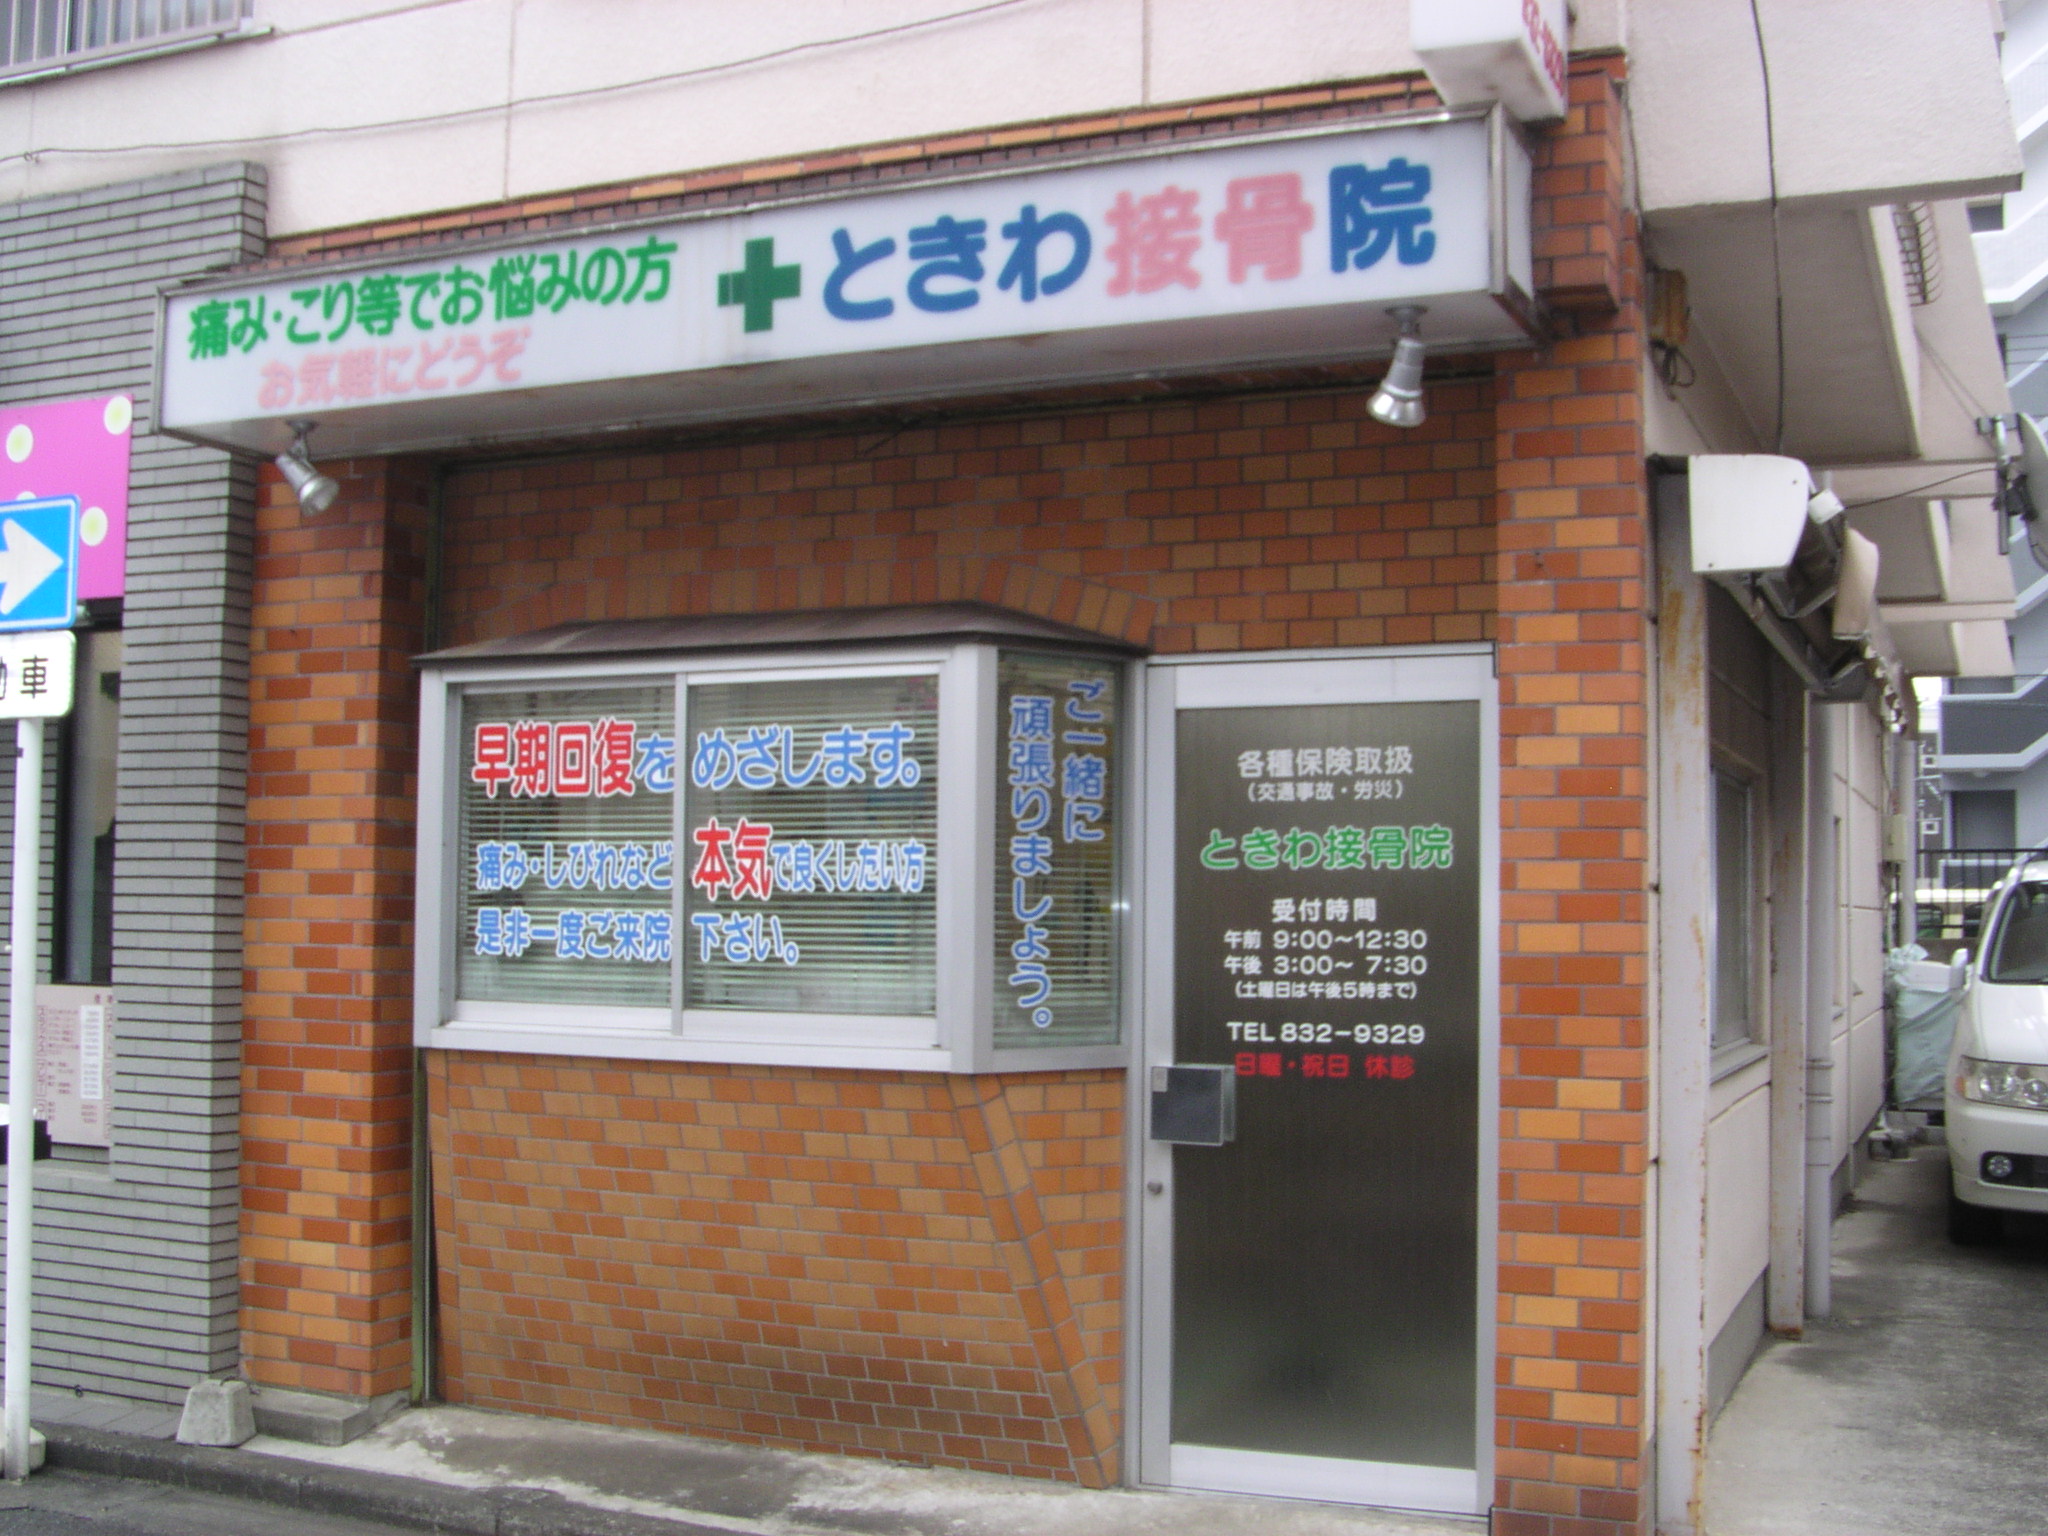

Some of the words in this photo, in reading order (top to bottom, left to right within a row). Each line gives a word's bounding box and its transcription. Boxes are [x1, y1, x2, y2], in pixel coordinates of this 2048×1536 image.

[822, 158, 1436, 321] ときわ接骨院
[189, 236, 678, 360] 痛み・こり等でお悩みの方
[257, 325, 532, 409] お気軽にどうぞ
[1062, 680, 1106, 843] ご一緒に
[1238, 745, 1414, 778] 各種保険取扱
[1009, 695, 1055, 1028] 頑張りましょう。
[1200, 823, 1453, 870] ときわ接骨院
[1272, 897, 1377, 922] 受付時間
[1224, 930, 1262, 949] 午前
[1224, 955, 1262, 975] 午後
[1226, 1022, 1275, 1042] TEL
[1364, 1053, 1415, 1079] 休診
